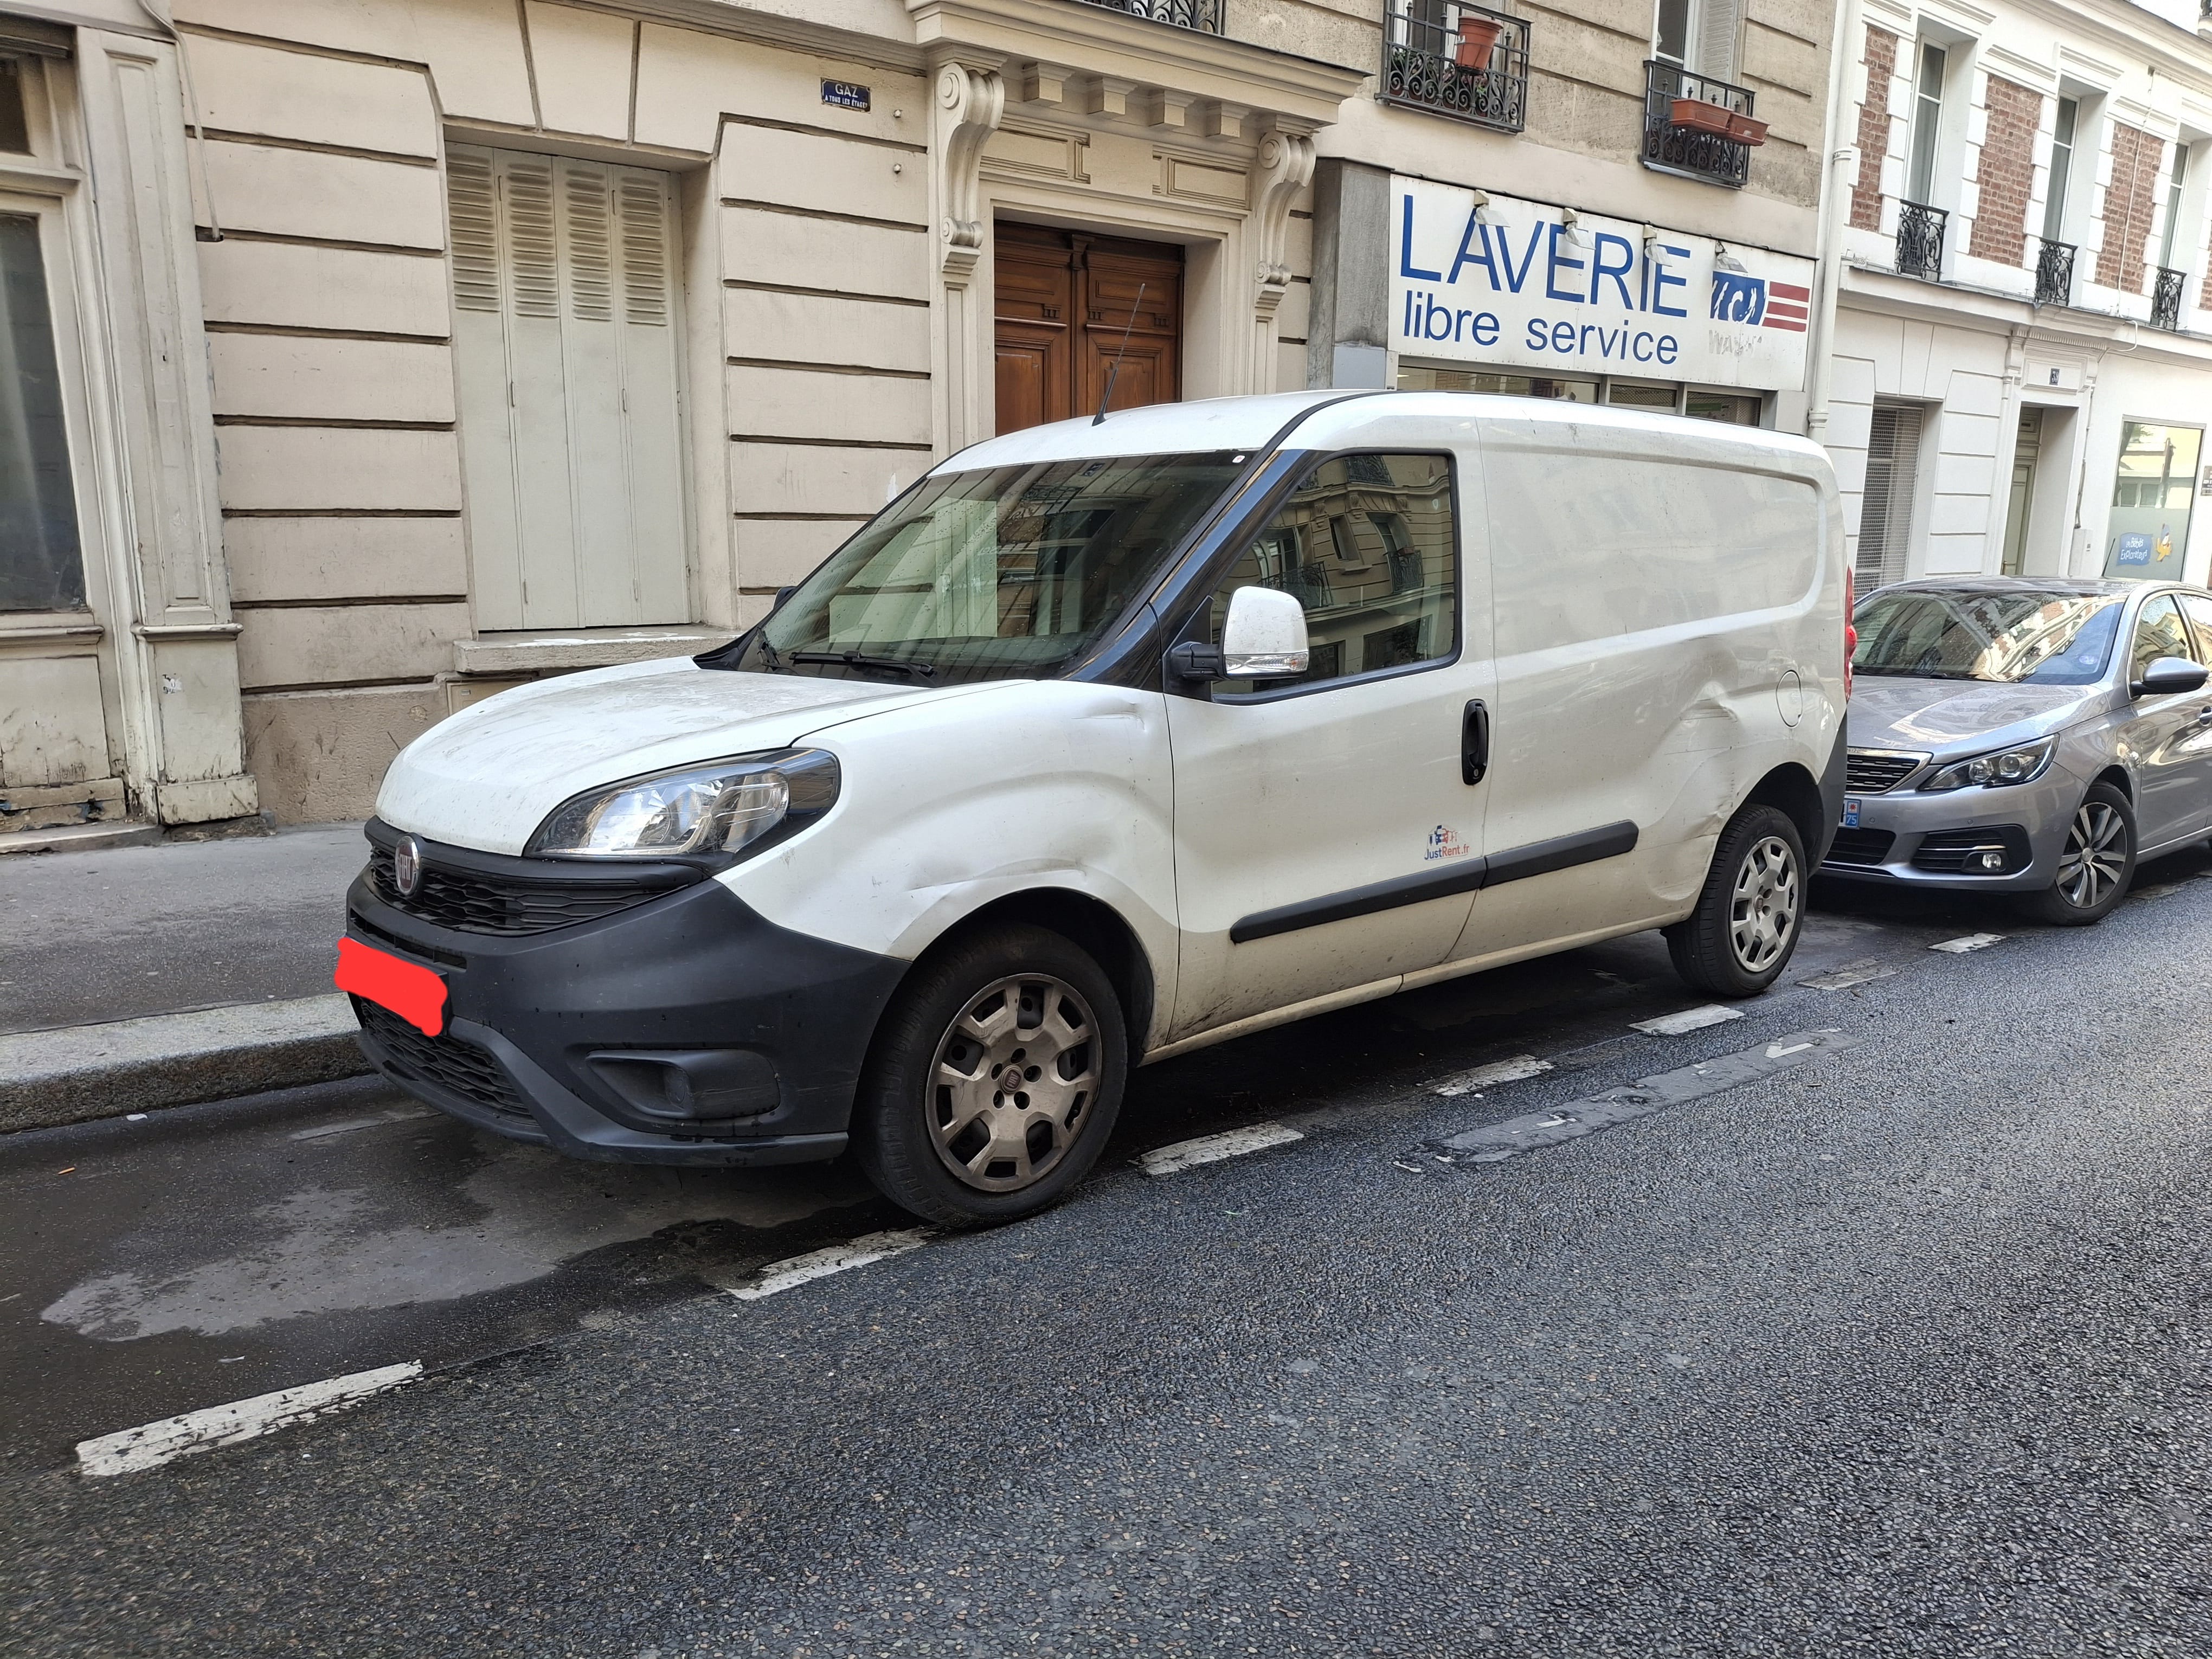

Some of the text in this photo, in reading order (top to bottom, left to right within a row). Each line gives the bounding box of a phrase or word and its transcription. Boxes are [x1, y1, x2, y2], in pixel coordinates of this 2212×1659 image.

[835, 83, 858, 98] GAZ
[1400, 195, 1690, 317] LAVERIE
[1404, 290, 1500, 345] libre
[1526, 319, 1679, 364] service
[1847, 815, 1857, 824] 75
[399, 853, 412, 880] FIAT
